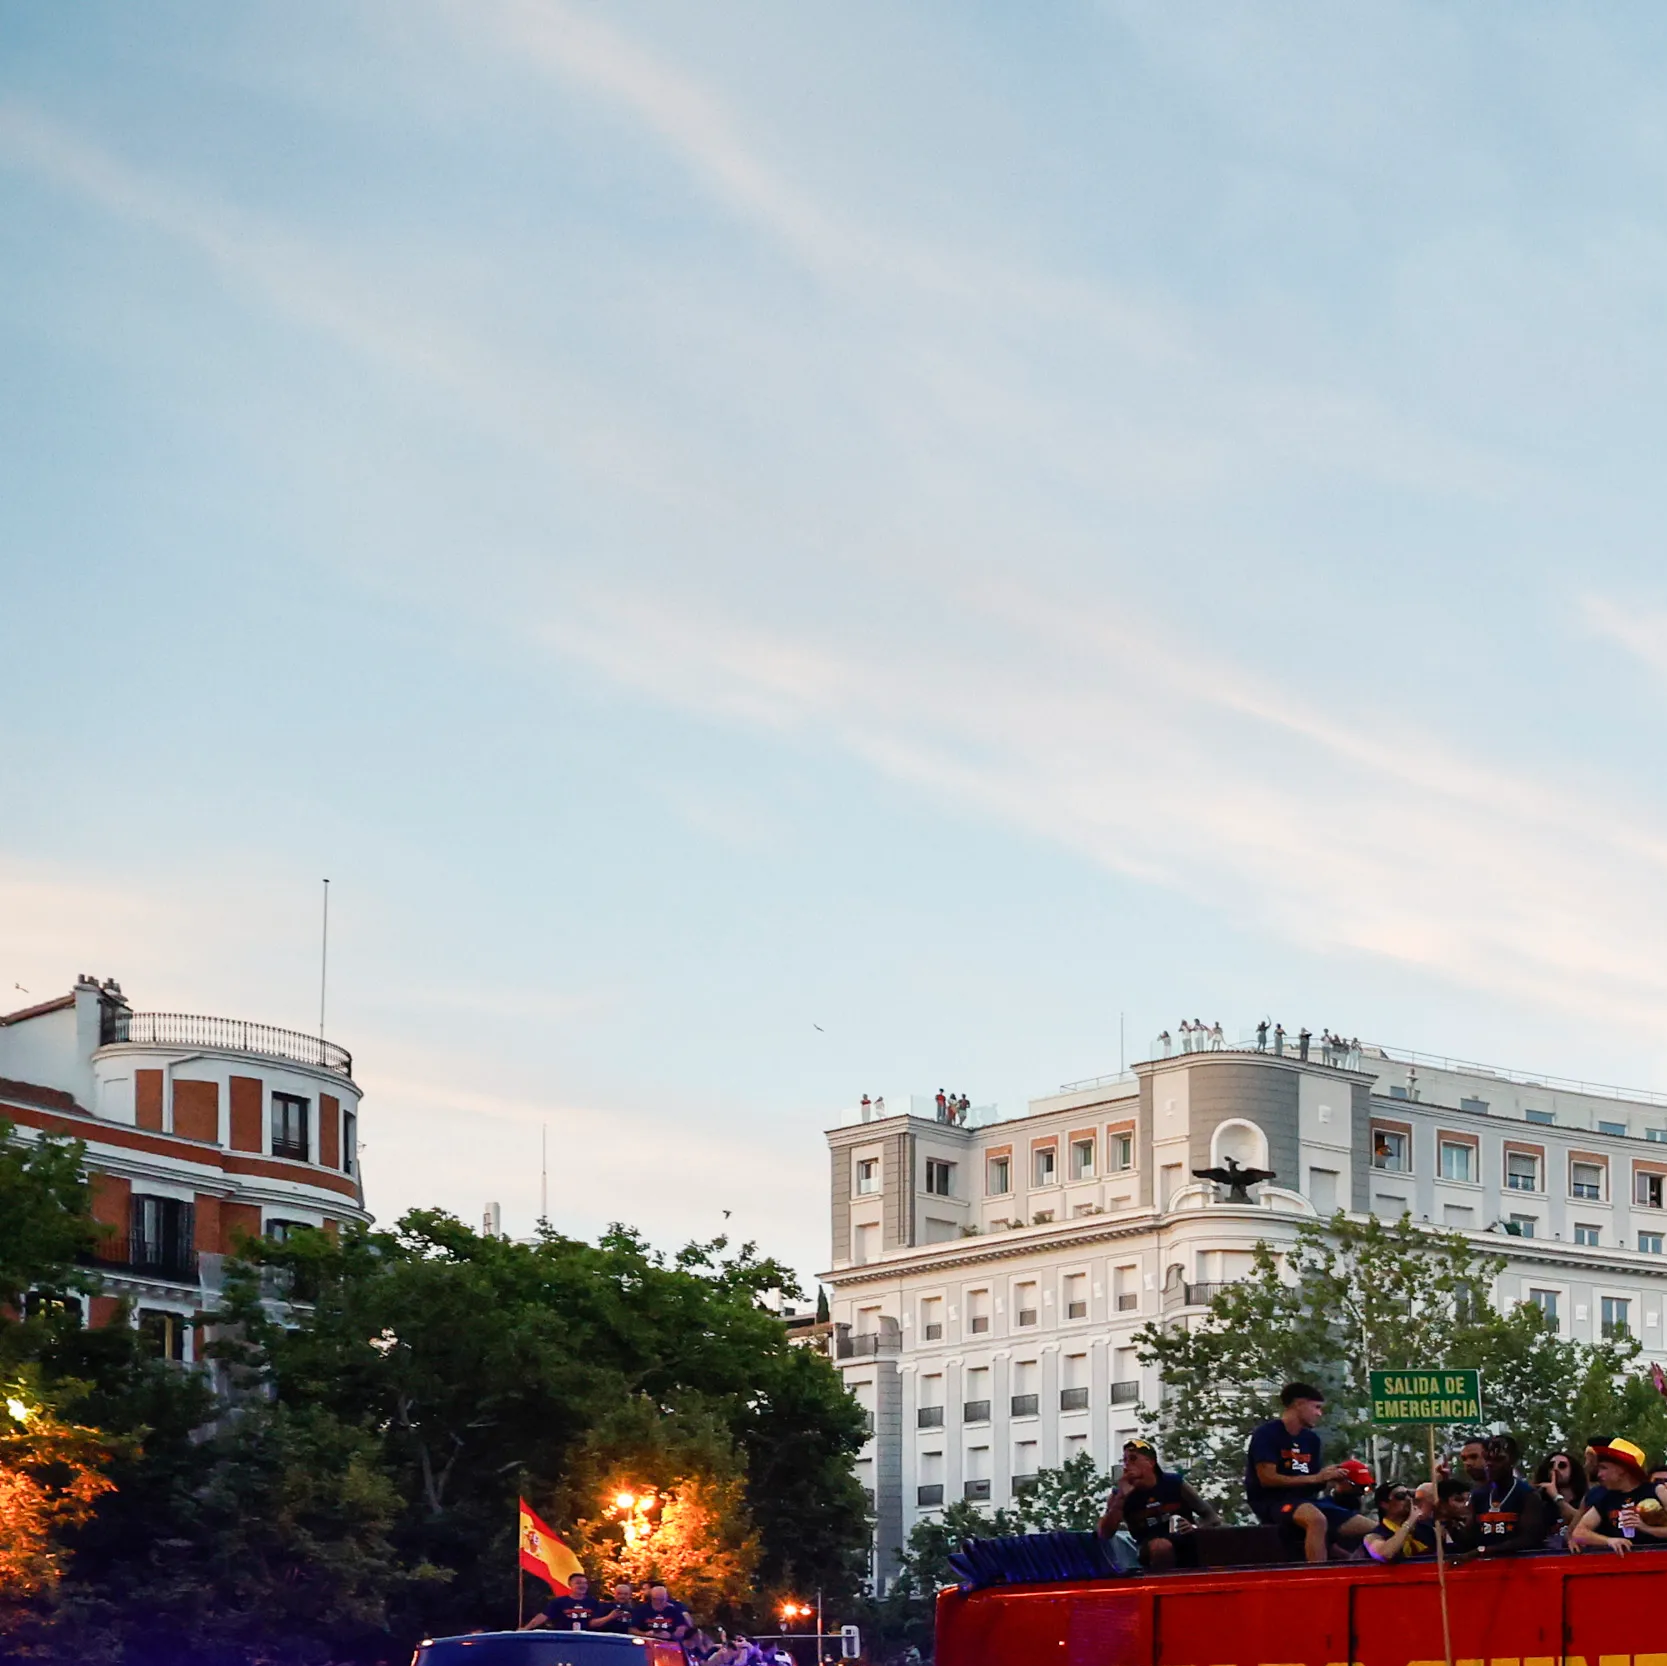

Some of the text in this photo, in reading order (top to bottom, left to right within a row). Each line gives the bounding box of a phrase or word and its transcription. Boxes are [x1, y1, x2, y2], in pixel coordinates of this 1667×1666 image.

[1384, 1376, 1466, 1395] SALIDA DE
[1375, 1399, 1478, 1418] EMERGENCIA
